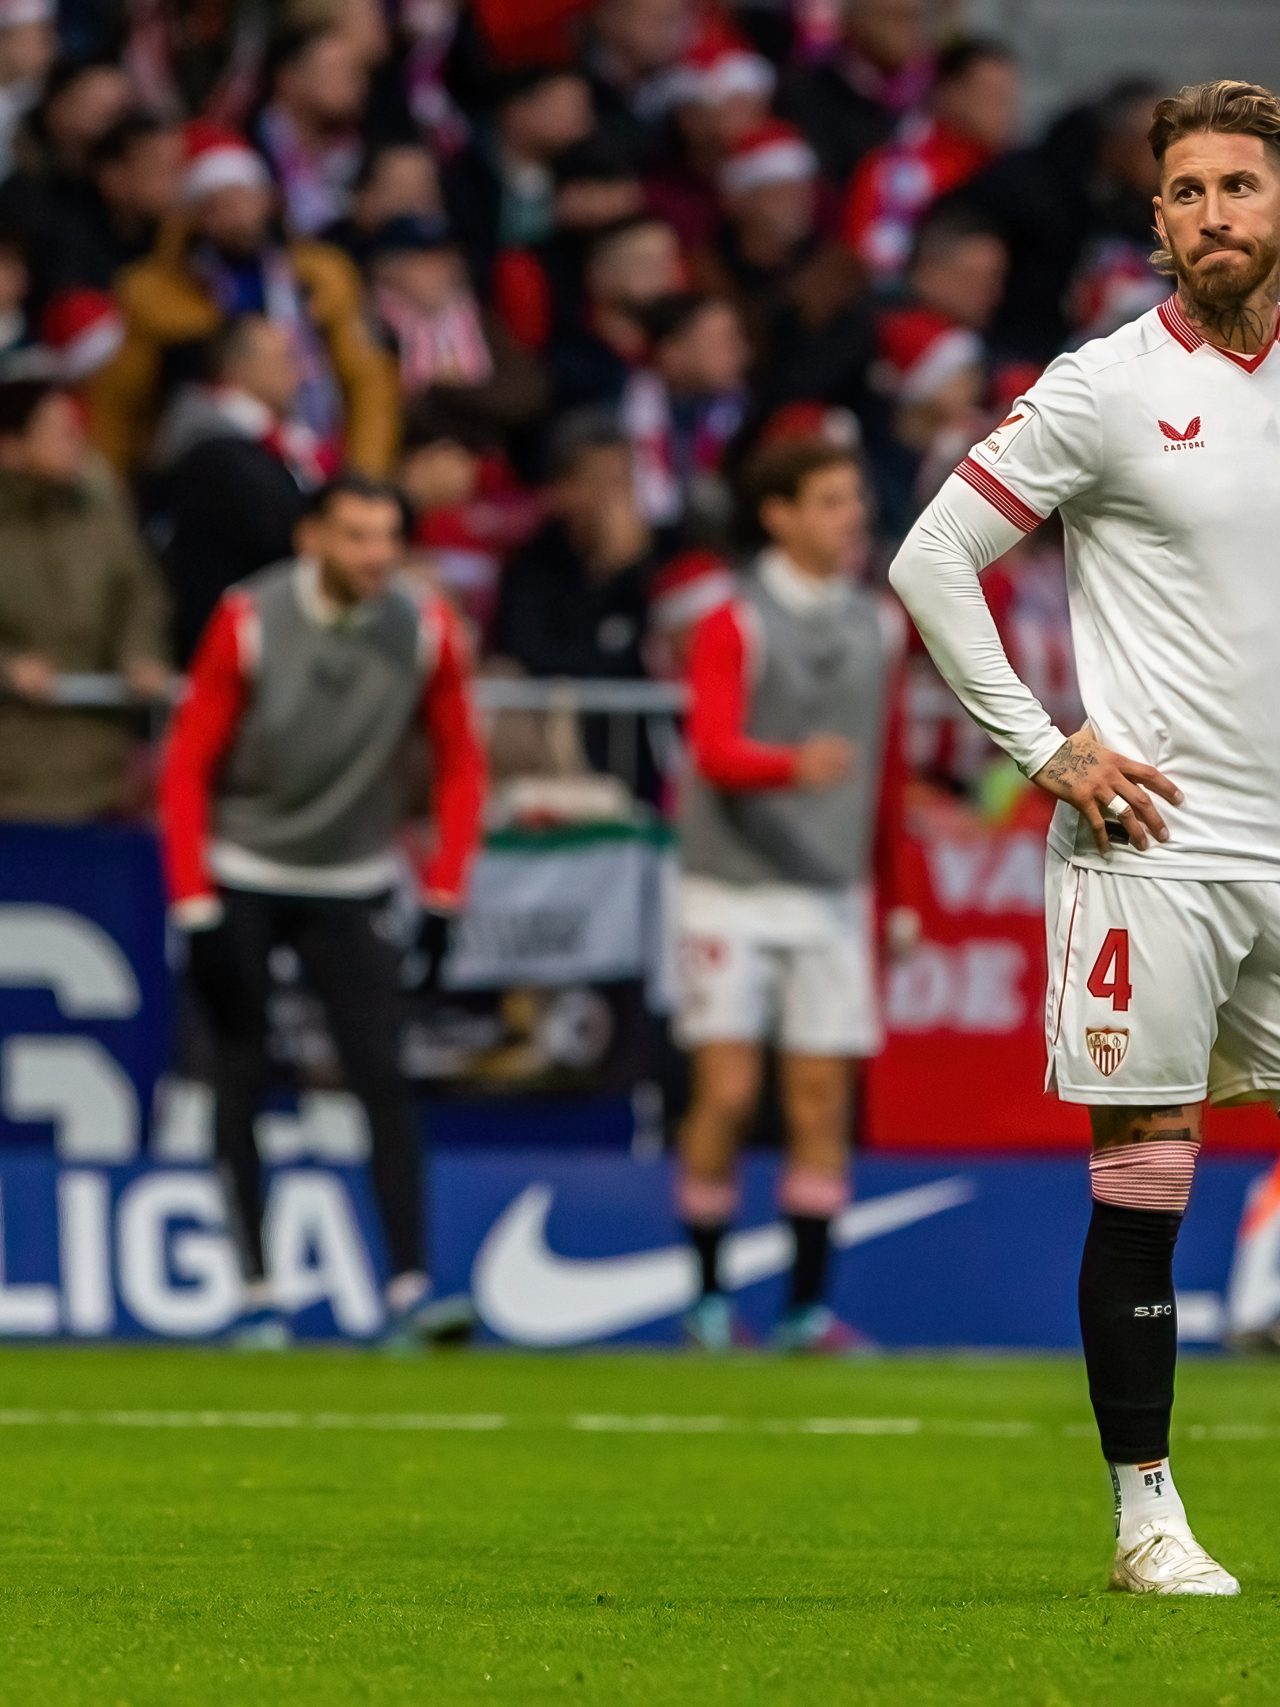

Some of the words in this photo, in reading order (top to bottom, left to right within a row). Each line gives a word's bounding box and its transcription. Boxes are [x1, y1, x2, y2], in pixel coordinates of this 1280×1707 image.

[983, 438, 1000, 455] IGA
[1163, 440, 1206, 452] CASTORE
[1087, 928, 1132, 1011] 4
